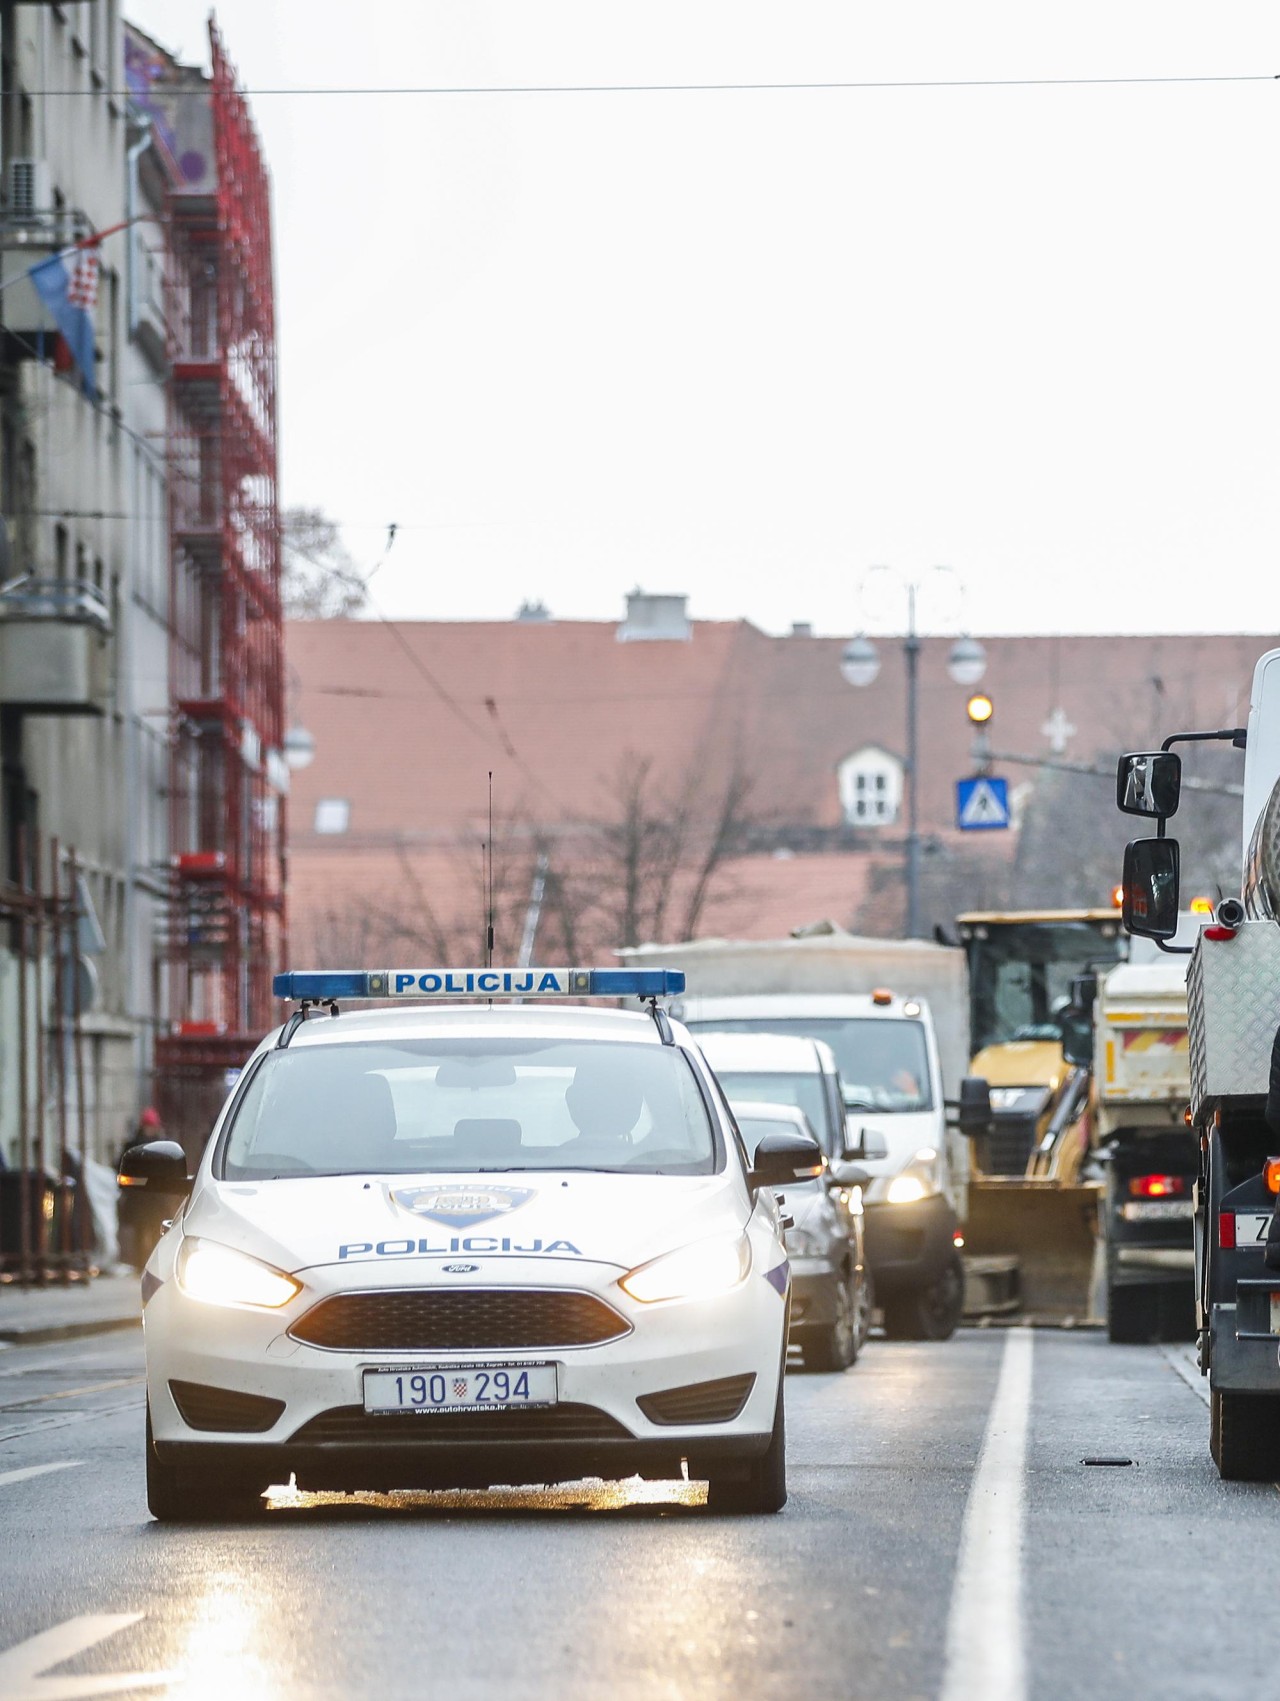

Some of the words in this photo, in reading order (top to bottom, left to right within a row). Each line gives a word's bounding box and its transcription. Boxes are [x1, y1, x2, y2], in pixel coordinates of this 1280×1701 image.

[395, 973, 562, 993] POLICIJA
[338, 1237, 584, 1260] POLICIJA
[396, 1375, 446, 1405] 190
[474, 1371, 530, 1402] 294
[414, 1403, 507, 1415] www.autohrvatska.hr
